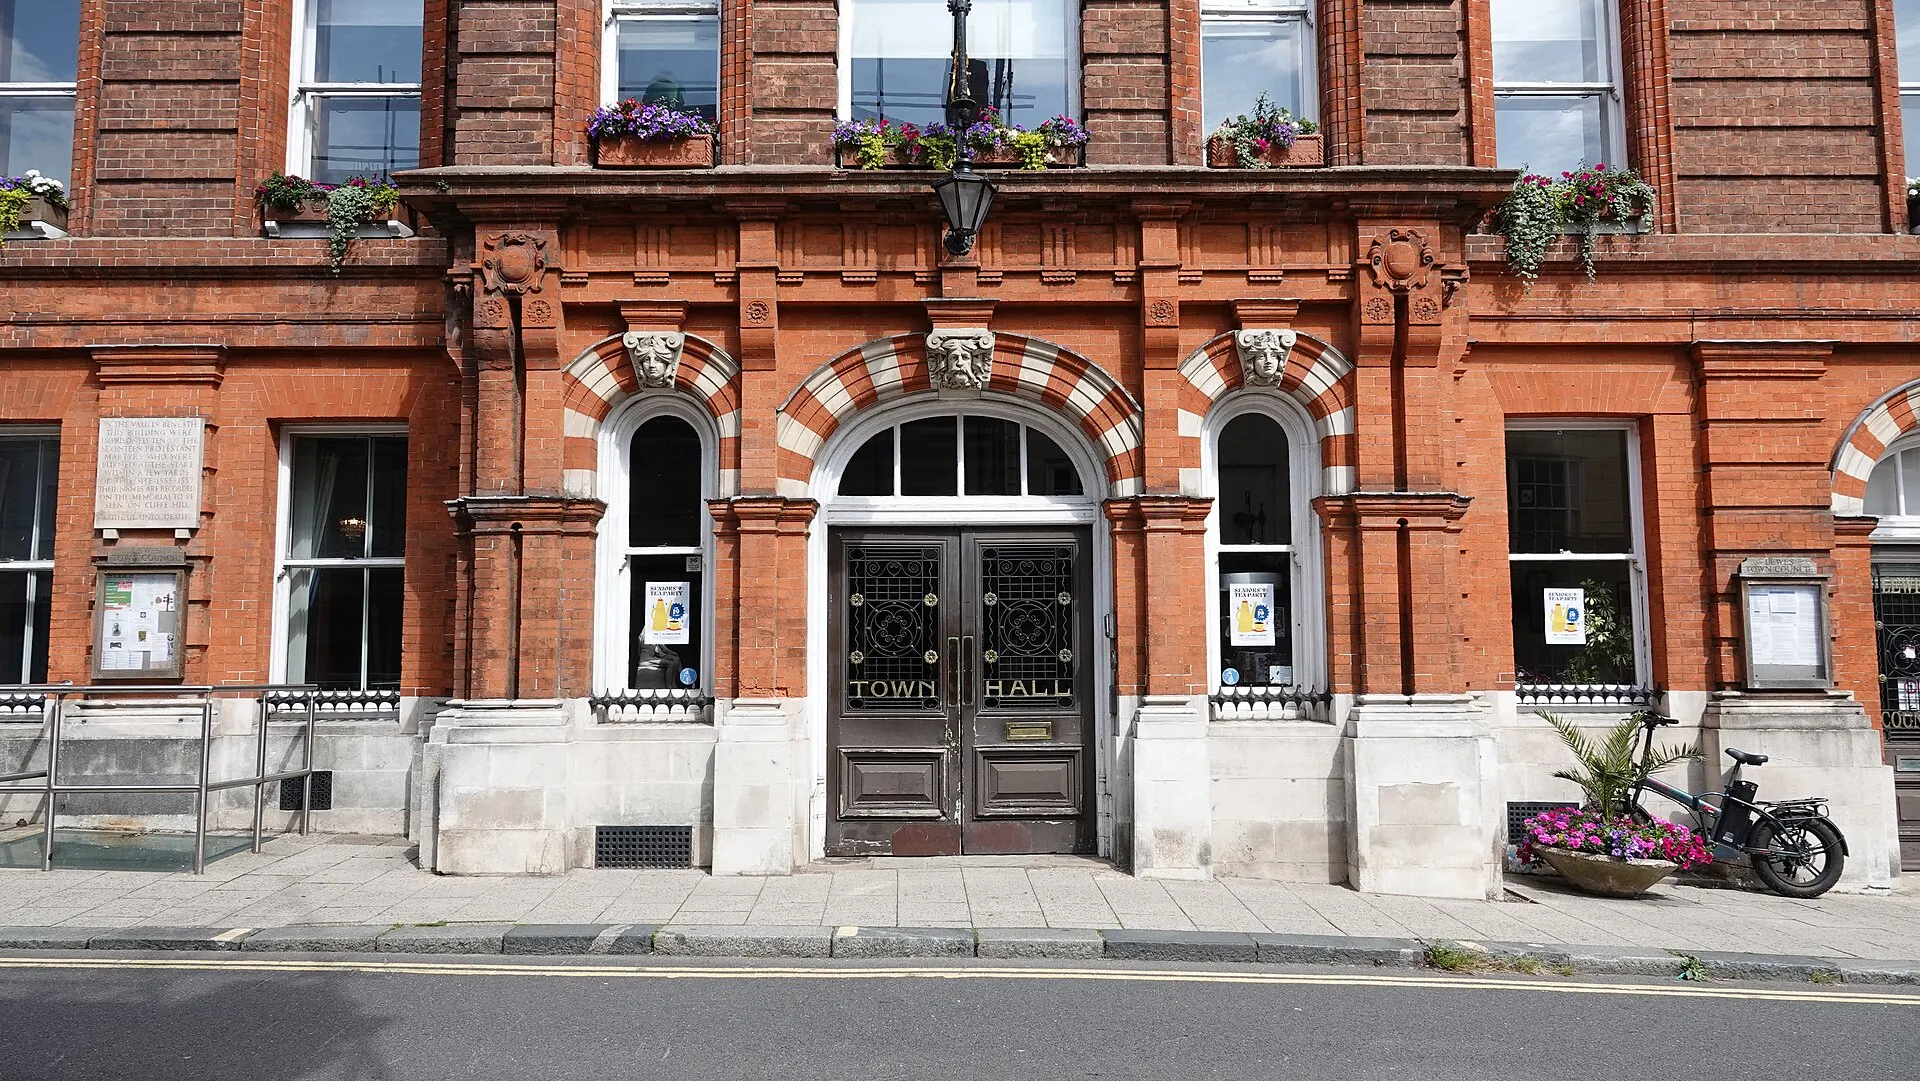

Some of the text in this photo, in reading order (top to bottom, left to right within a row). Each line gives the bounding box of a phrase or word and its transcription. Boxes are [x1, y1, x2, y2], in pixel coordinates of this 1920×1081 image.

[137, 477, 153, 485] SITE
[98, 485, 195, 493] THEIR NAMES ARE RECORDED
[1746, 565, 1812, 573] TOWN COUNCIL
[850, 680, 1071, 698] TOWN HALL
